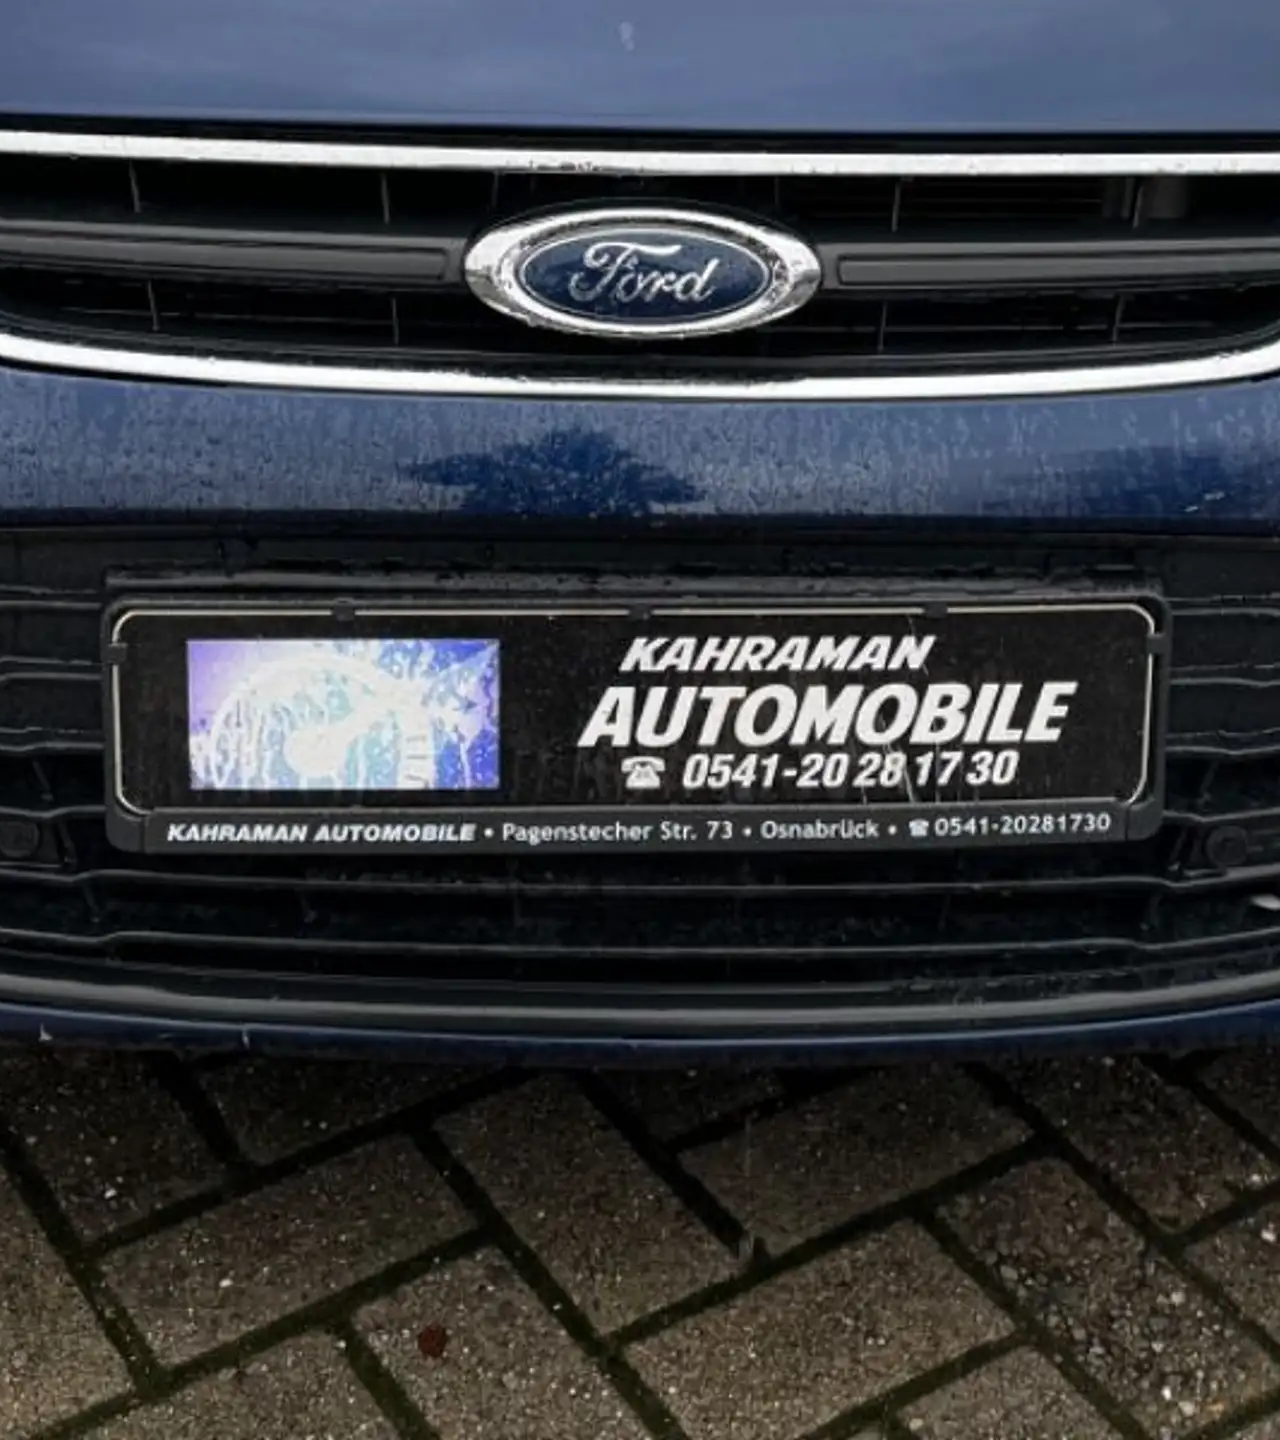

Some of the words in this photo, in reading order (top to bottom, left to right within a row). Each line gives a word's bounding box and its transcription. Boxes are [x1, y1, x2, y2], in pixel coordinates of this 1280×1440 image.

[568, 241, 723, 303] Ford
[619, 635, 936, 672] KAHRAMAN
[577, 681, 1078, 747] AUTOMOBILE
[682, 752, 850, 789] 0541-20
[167, 823, 308, 843] KAHRAMAN
[312, 823, 476, 843] AUTOMOBILE
[502, 821, 652, 847] Pagenstecher
[660, 821, 697, 841] Str.
[706, 820, 734, 840] 73
[760, 819, 879, 840] Osnabrück
[934, 811, 1111, 836] 0541-20281730
